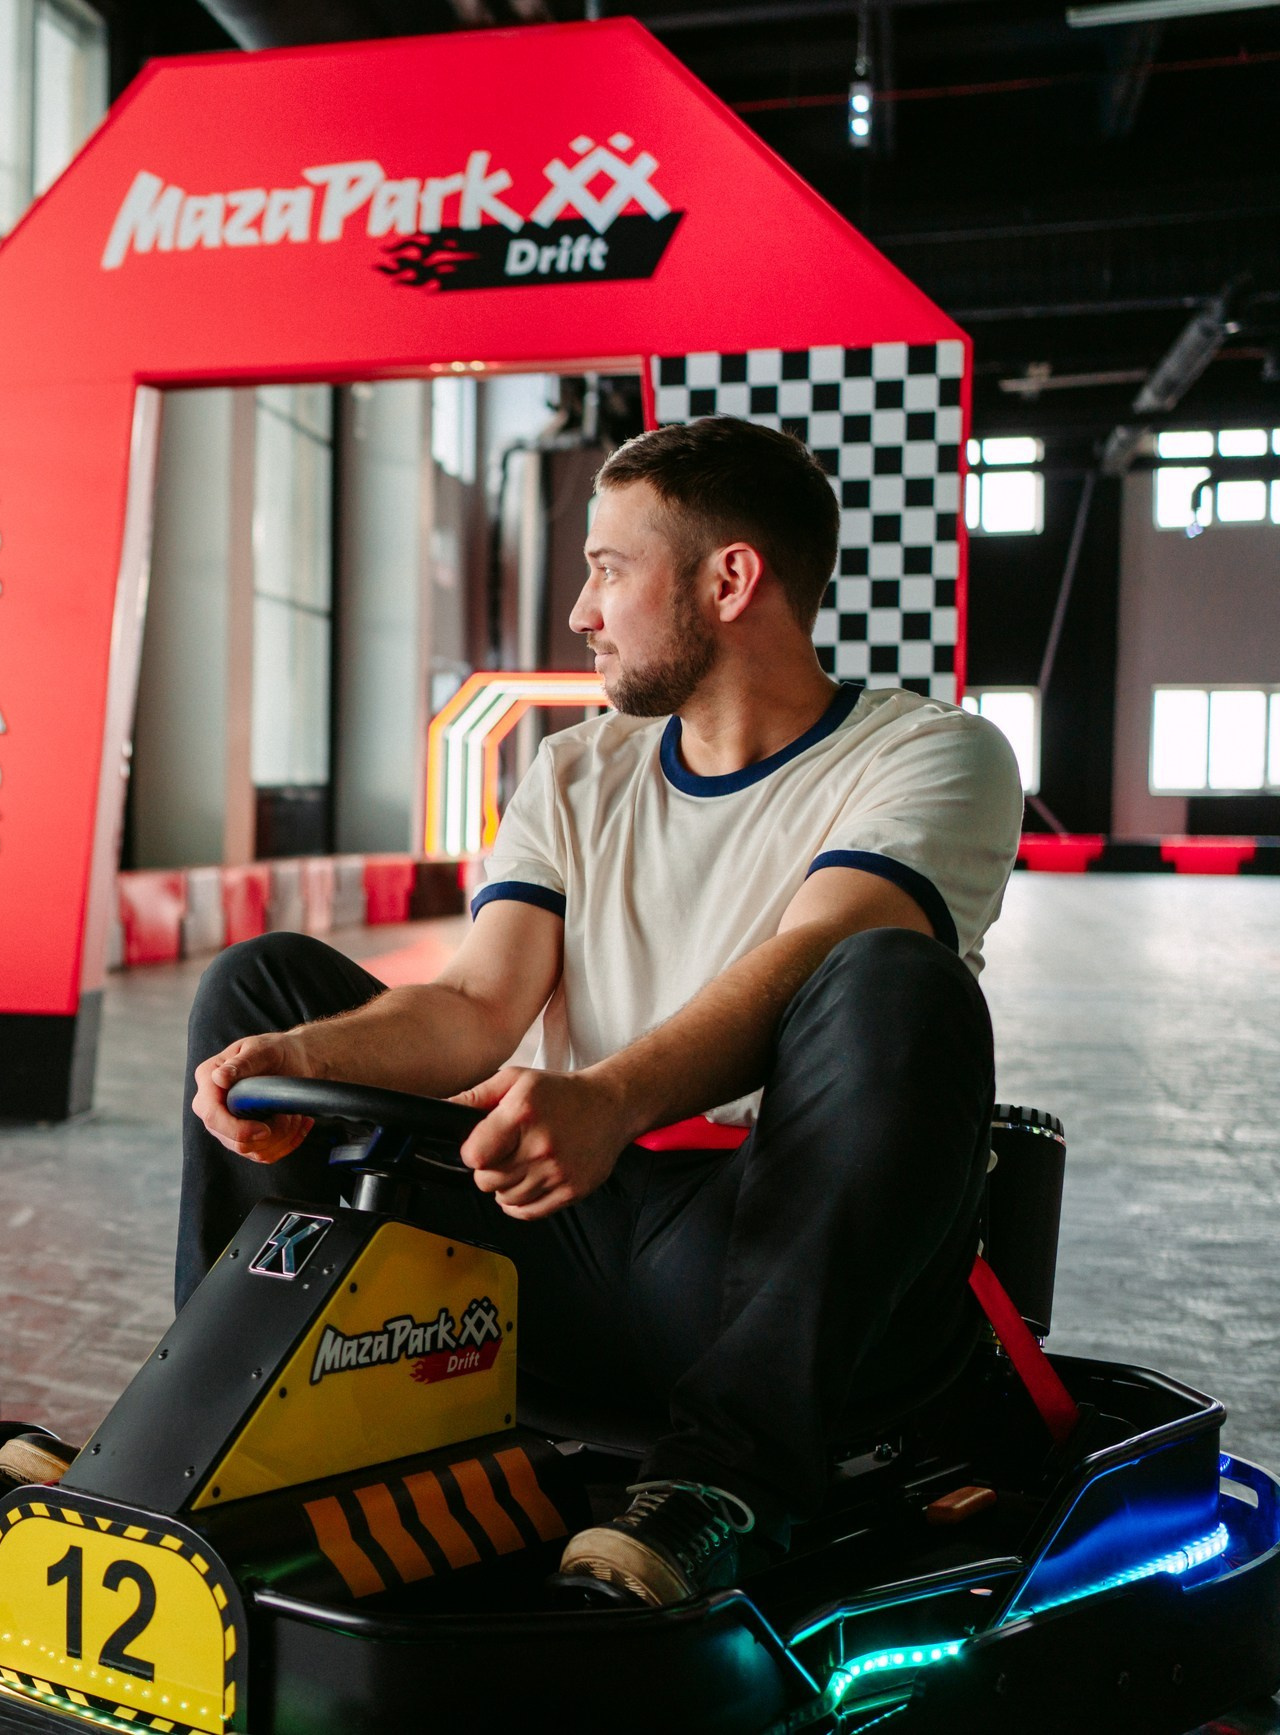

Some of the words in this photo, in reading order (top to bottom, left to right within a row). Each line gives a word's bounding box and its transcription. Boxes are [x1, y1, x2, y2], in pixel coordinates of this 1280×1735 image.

[101, 150, 524, 270] MazaPark
[503, 233, 609, 277] Drift
[311, 1311, 457, 1384] MazaPark
[446, 1351, 481, 1374] Drift
[47, 1544, 157, 1684] 12
